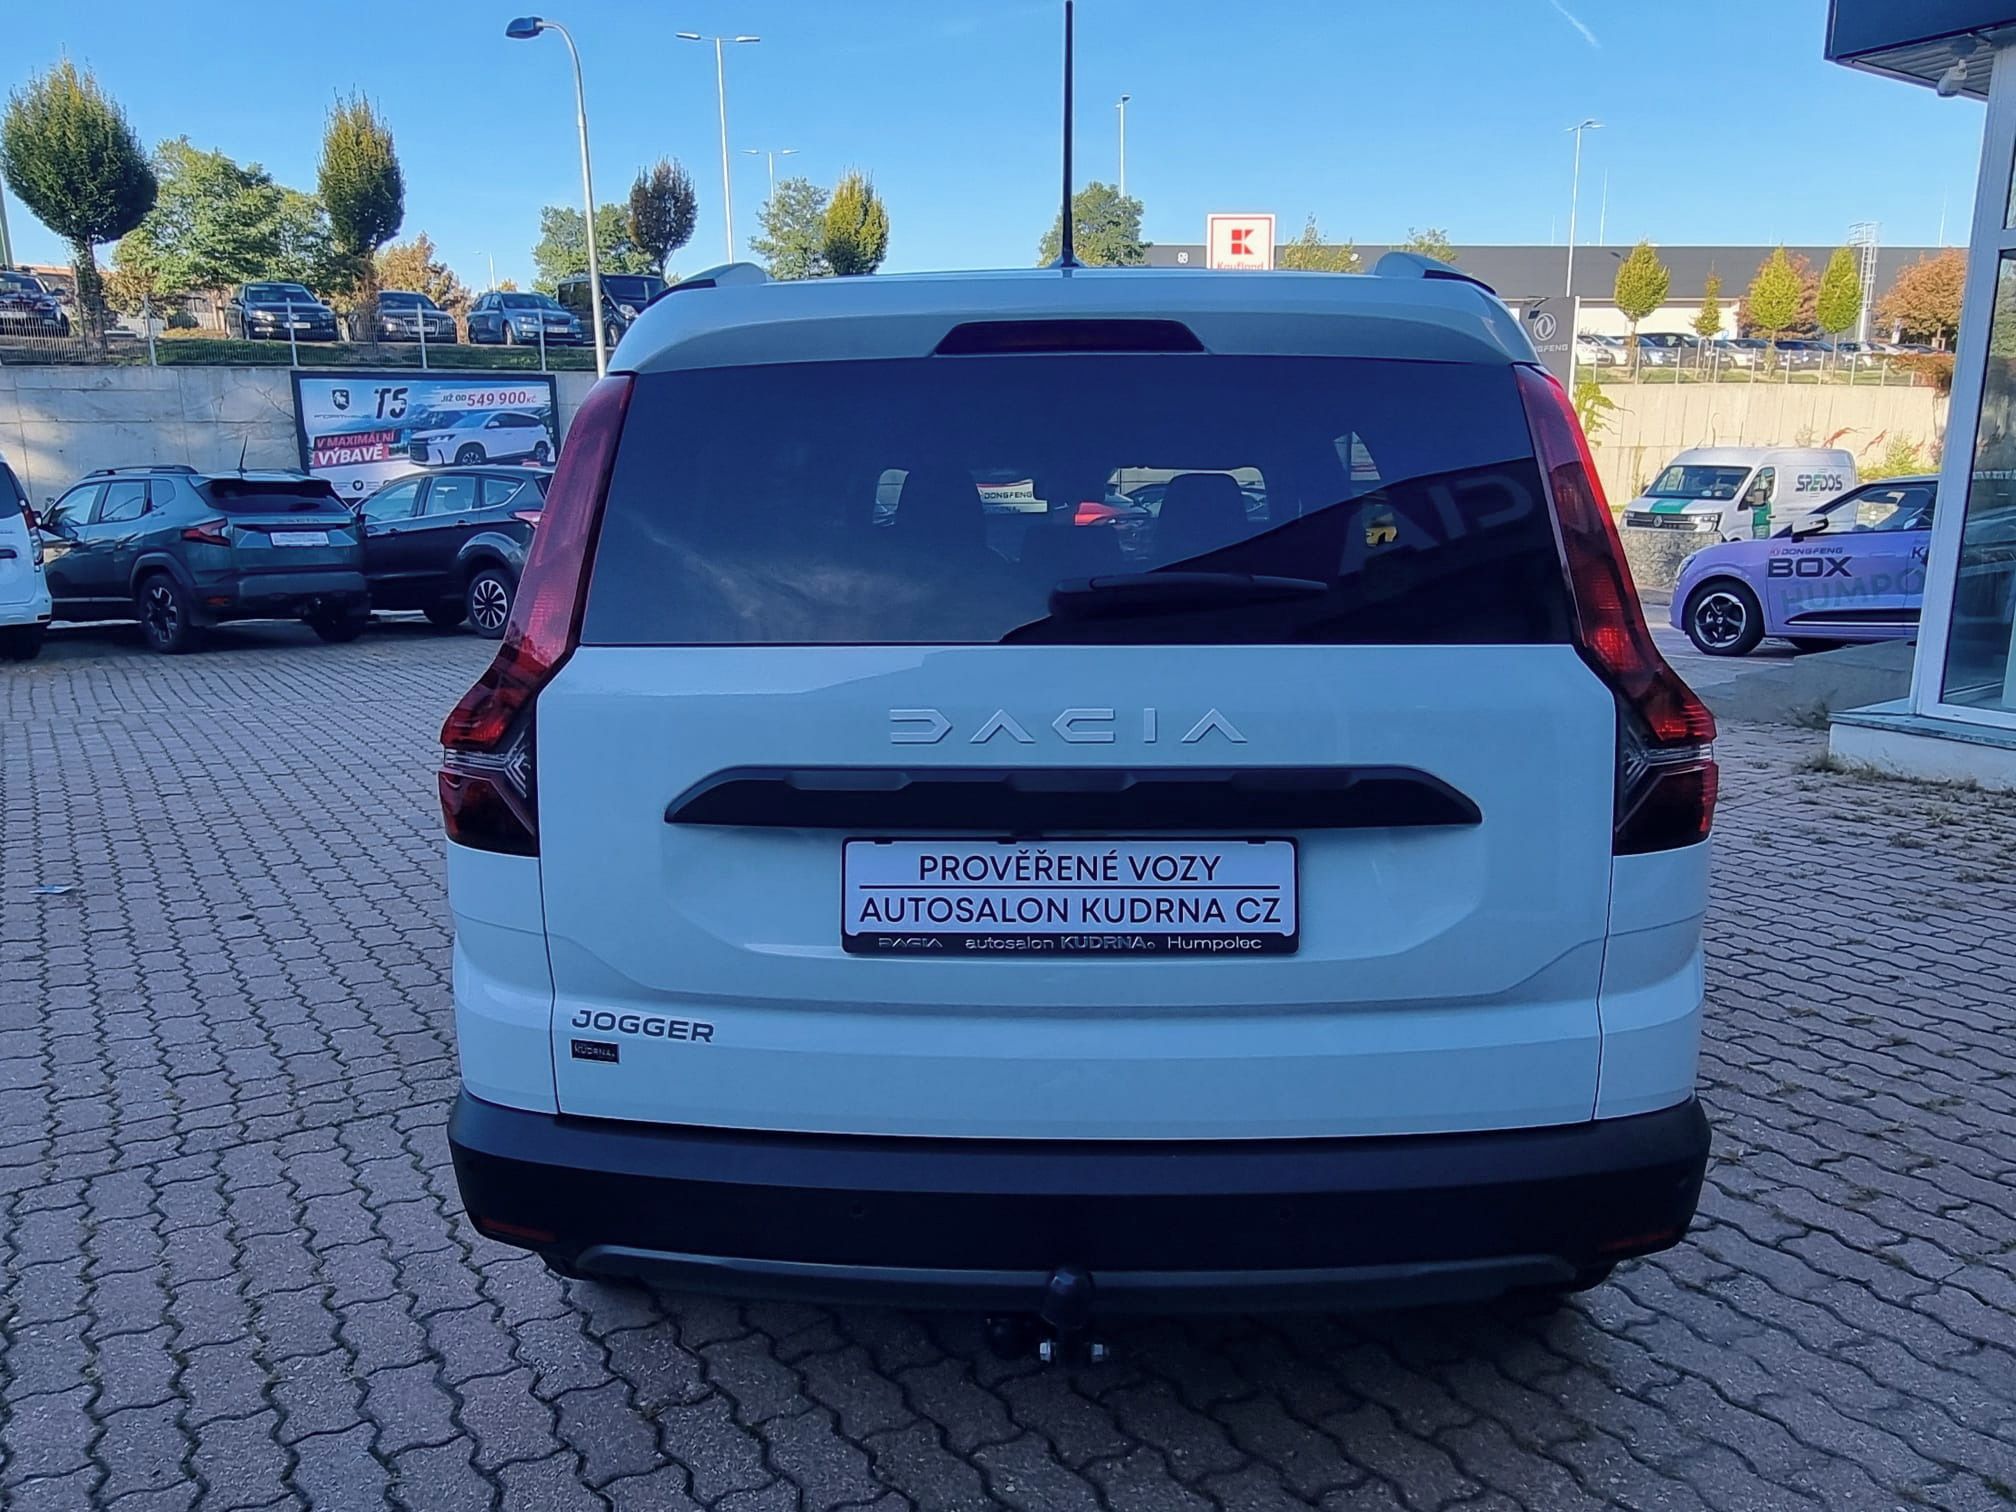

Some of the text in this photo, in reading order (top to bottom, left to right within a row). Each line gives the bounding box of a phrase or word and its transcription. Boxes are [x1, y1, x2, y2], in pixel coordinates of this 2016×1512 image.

[374, 387, 409, 419] T5
[467, 393, 495, 407] 549
[499, 391, 526, 405] 900
[316, 431, 395, 449] V MAXIMÁLNÍ
[318, 443, 384, 466] VÝBAVĚ
[1795, 474, 1843, 492] SPEDOS
[1780, 547, 1844, 556] DONGFENG
[1767, 556, 1853, 578] BOX
[889, 707, 1249, 744] DACIA
[919, 849, 1222, 881] PROVĚŘENÉ VOZY
[859, 896, 1282, 924] AUTOSALON KUDRNA CZ
[965, 936, 1054, 950] autosalon
[1167, 936, 1262, 951] Humpolec
[571, 1009, 714, 1042] JOGGER
